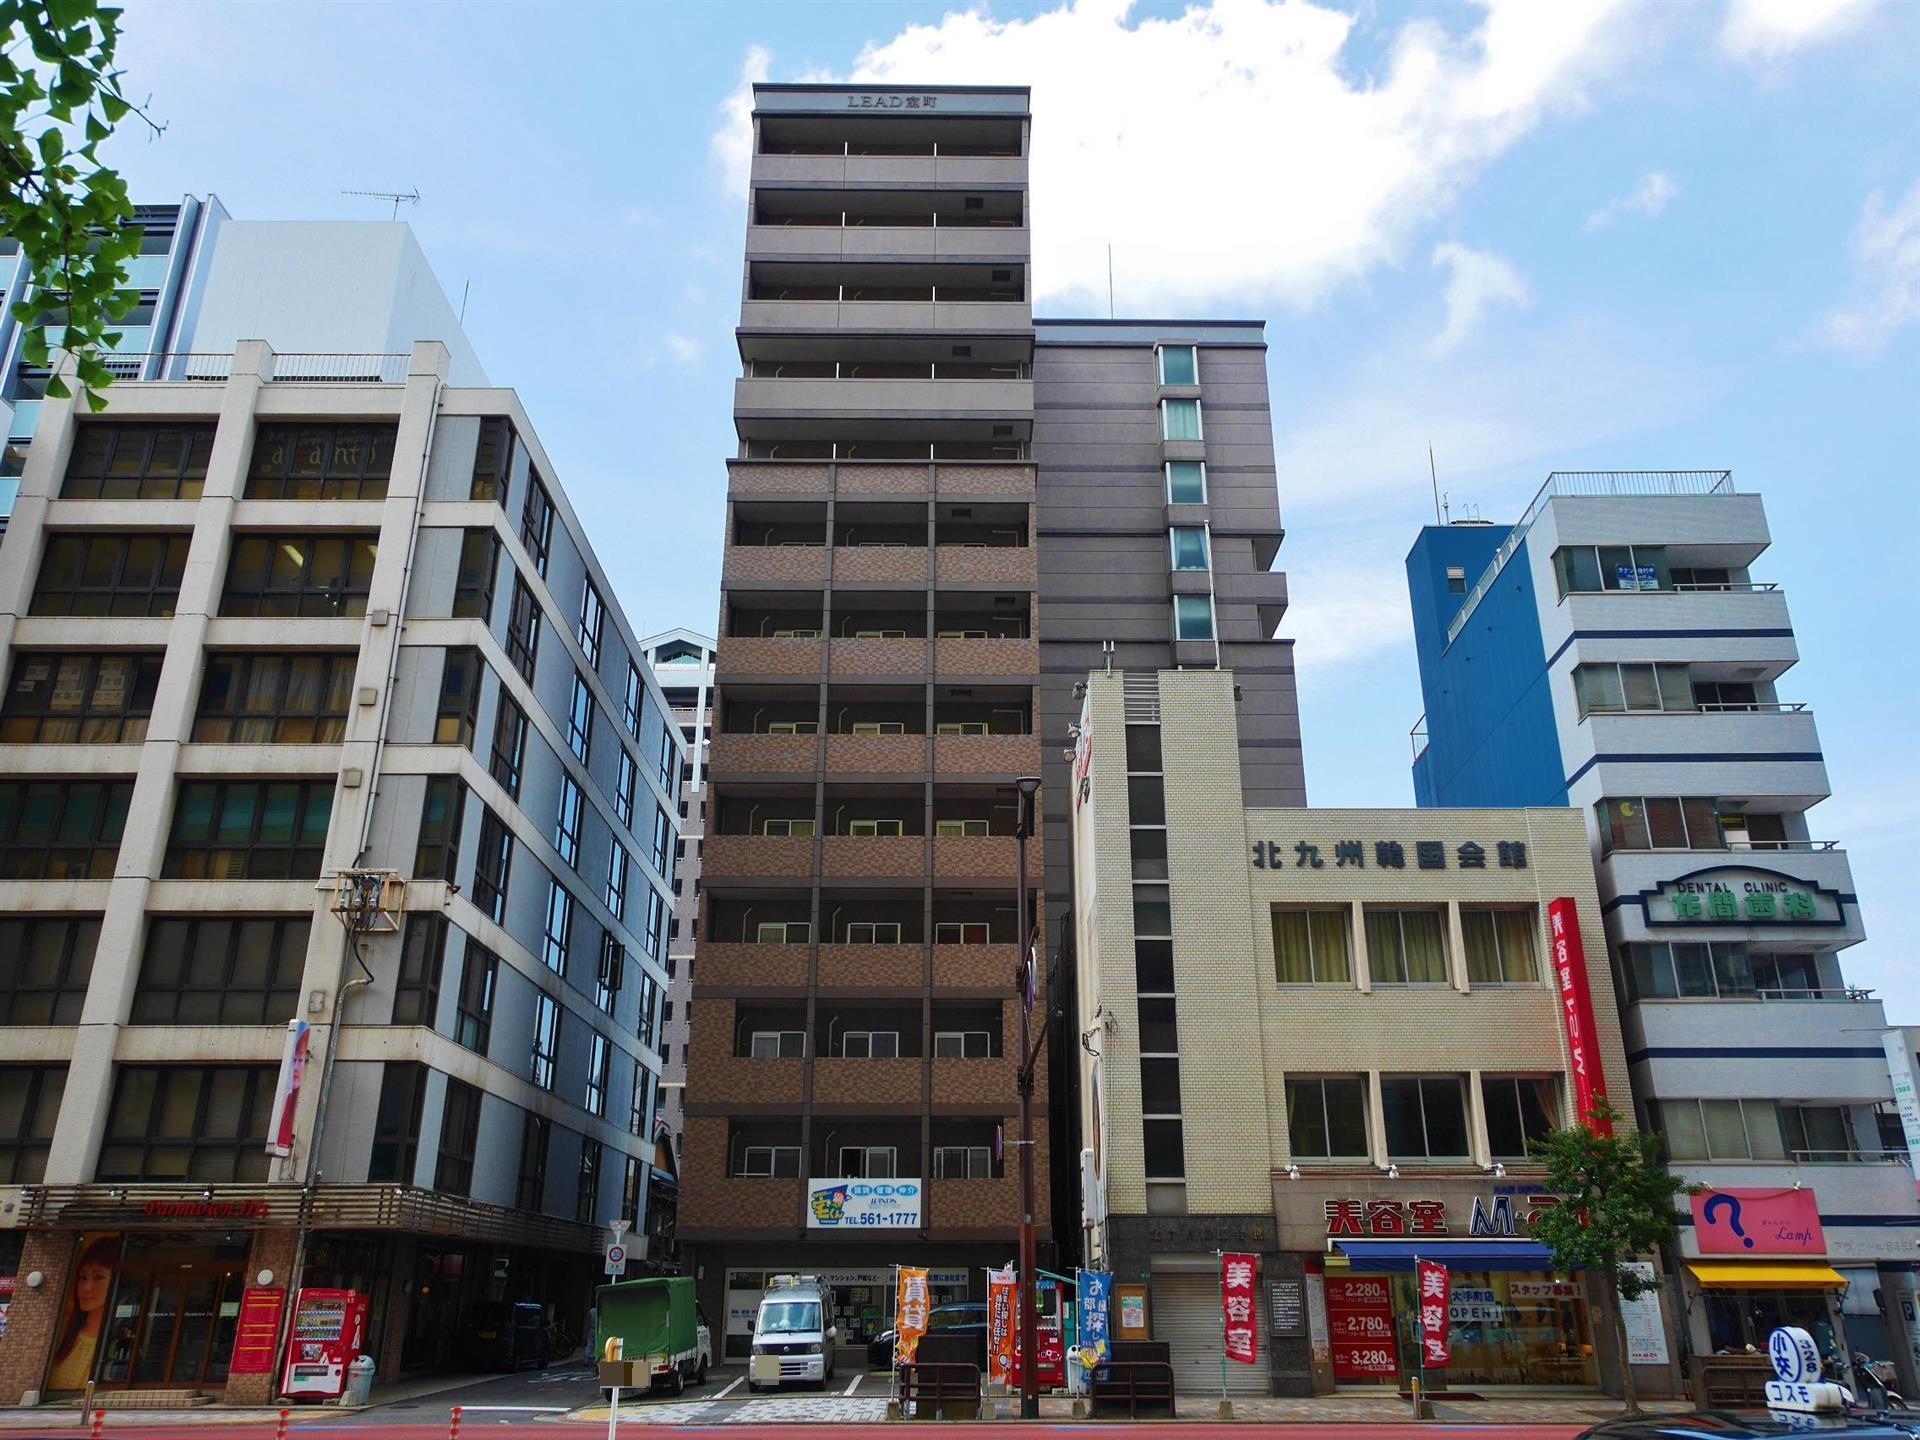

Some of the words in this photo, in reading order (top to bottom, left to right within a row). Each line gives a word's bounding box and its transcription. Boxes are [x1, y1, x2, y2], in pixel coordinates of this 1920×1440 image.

[847, 95, 938, 109] LEAD室町
[1252, 840, 1528, 870] 北九州韓国会館
[1677, 882, 1731, 893] DENTAL
[1743, 882, 1788, 893] CLINIC
[1671, 892, 1817, 919] 作間歯科
[1551, 911, 1572, 991] 美容室
[860, 1213, 918, 1225] 561-1777
[1323, 1199, 1449, 1234] 美容室
[1775, 1227, 1813, 1246] Lamp
[903, 1276, 927, 1330] 賃貸
[1226, 1261, 1253, 1357] 美容室
[1452, 1291, 1495, 1302] 大手町店
[1421, 1270, 1448, 1363] 美容室
[1903, 1303, 1913, 1319] P
[1799, 1340, 1818, 1373] 328
[1771, 1384, 1810, 1403] コスモ
